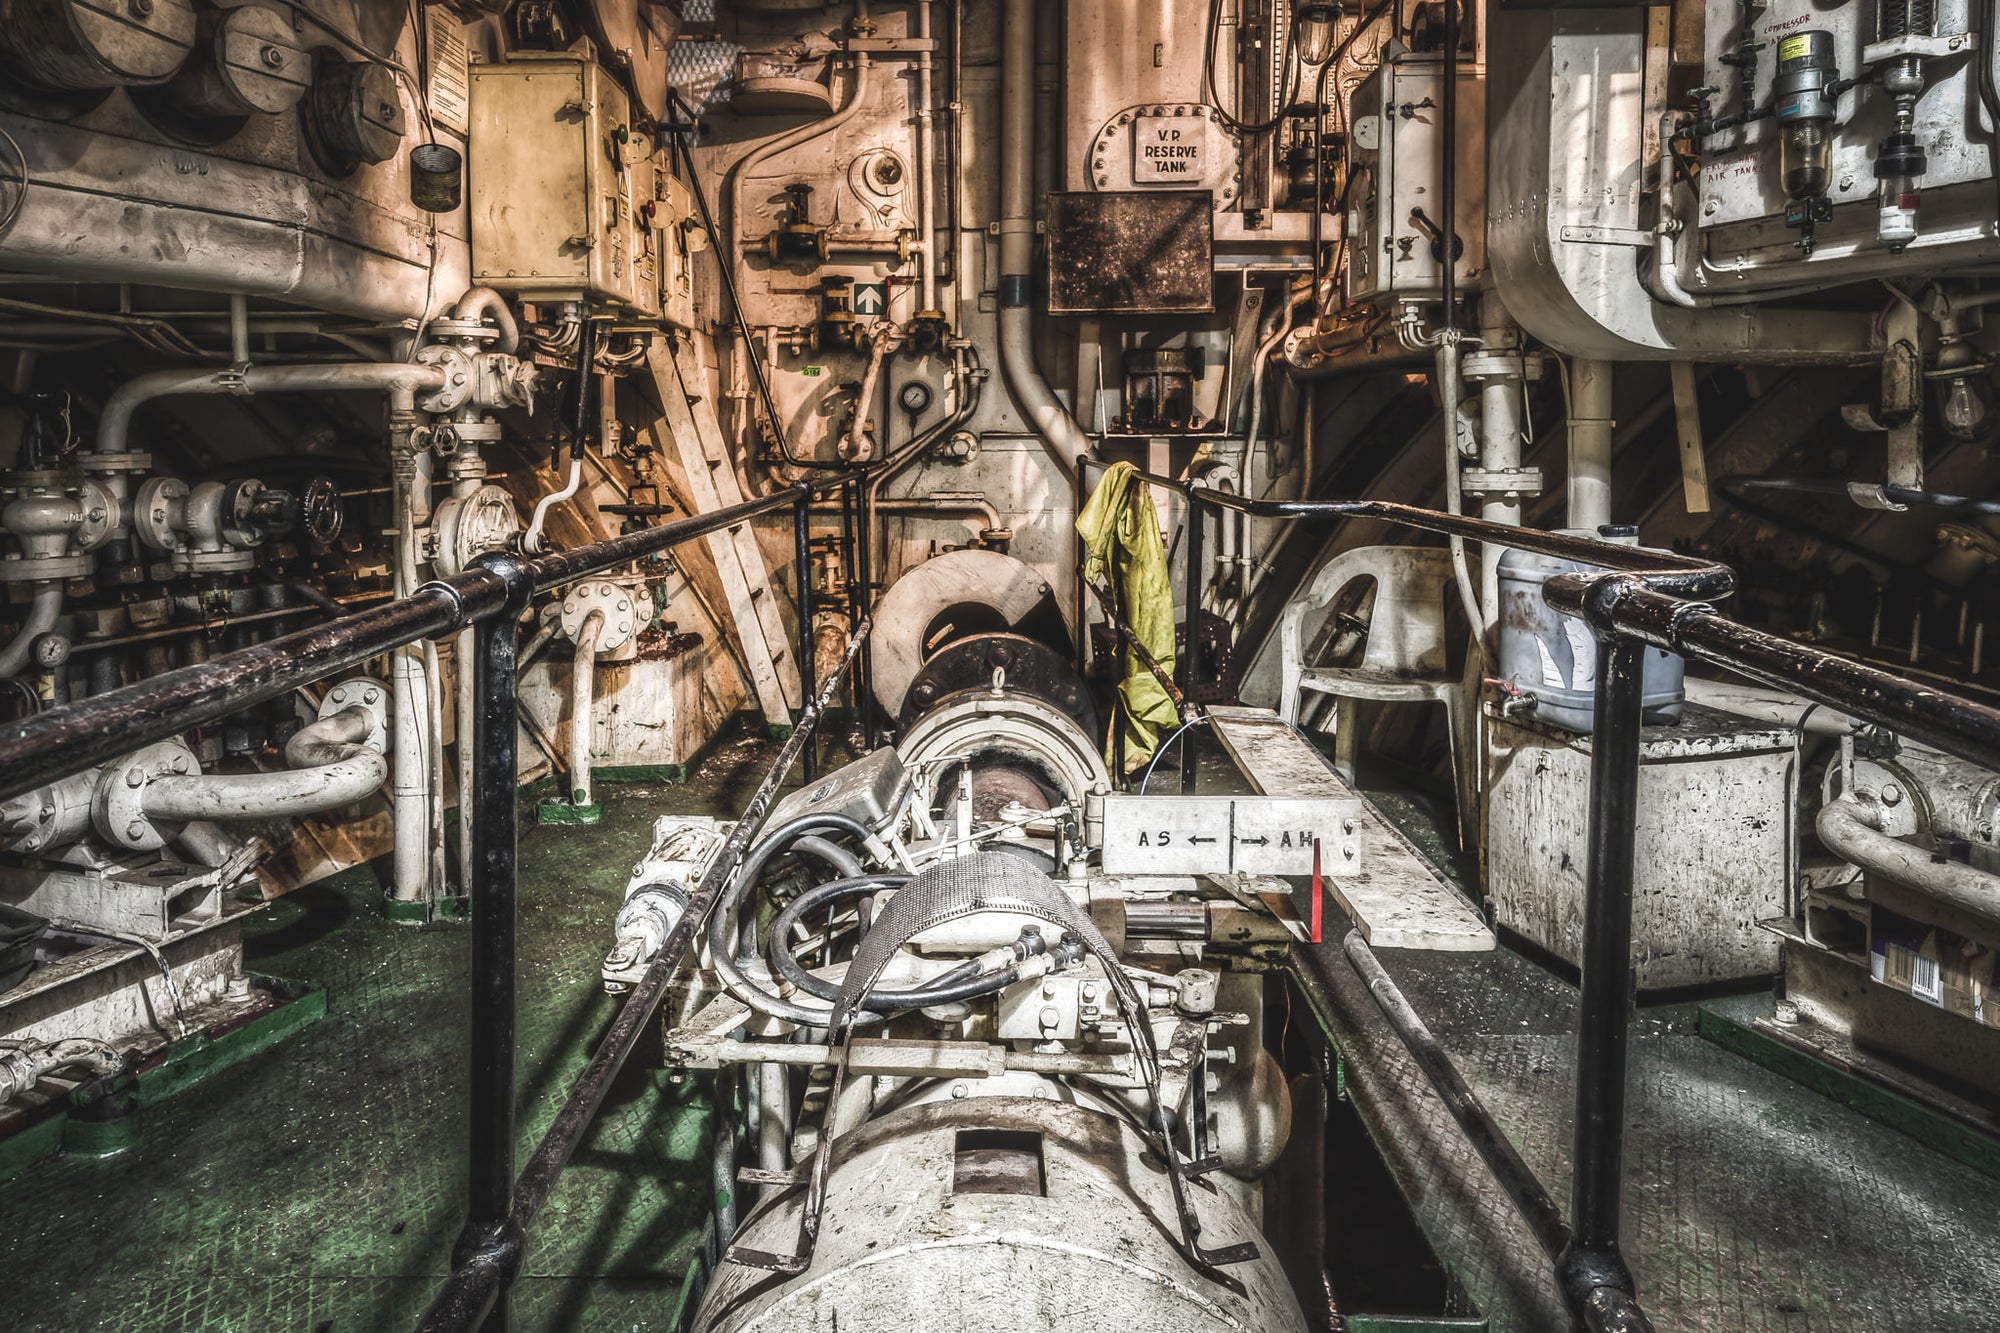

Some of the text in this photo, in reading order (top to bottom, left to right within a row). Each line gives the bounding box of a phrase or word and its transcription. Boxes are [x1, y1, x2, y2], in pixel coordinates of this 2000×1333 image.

[1764, 13, 1811, 34] COMPRESSOR
[1145, 146, 1197, 158] RESERVE
[1154, 161, 1186, 173] TANK
[1707, 171, 1726, 183] AIR
